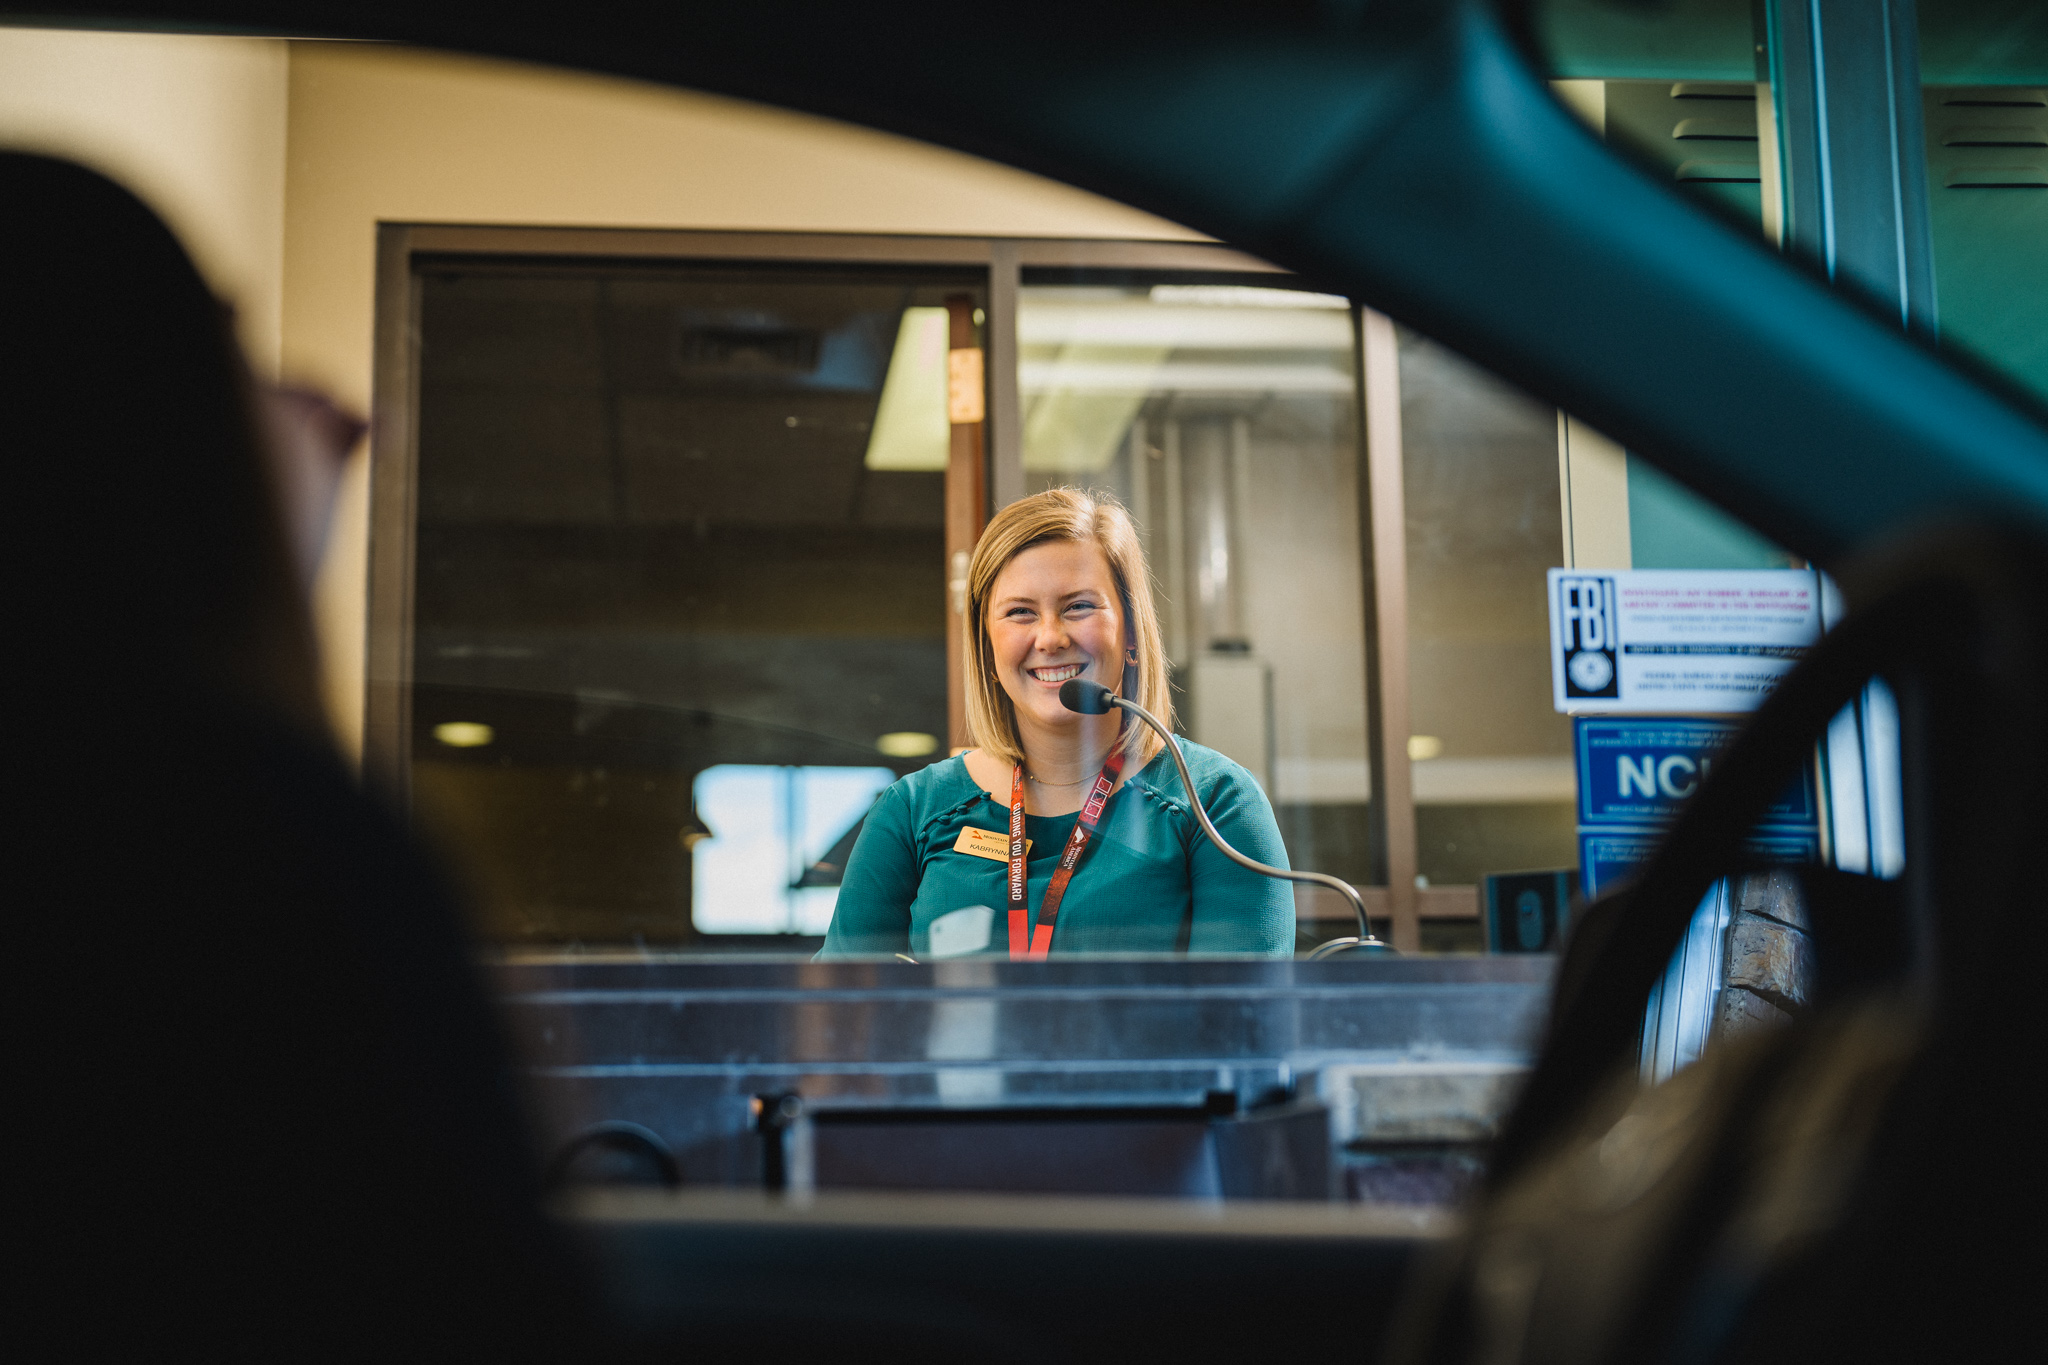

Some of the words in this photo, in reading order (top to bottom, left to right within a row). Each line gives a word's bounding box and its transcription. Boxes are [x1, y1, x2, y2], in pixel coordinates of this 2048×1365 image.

[1563, 578, 1615, 650] FBI
[1617, 754, 1711, 799] NC
[1012, 802, 1021, 837] GUIDING
[1011, 838, 1022, 856] YOU
[1011, 858, 1022, 900] FORWARD
